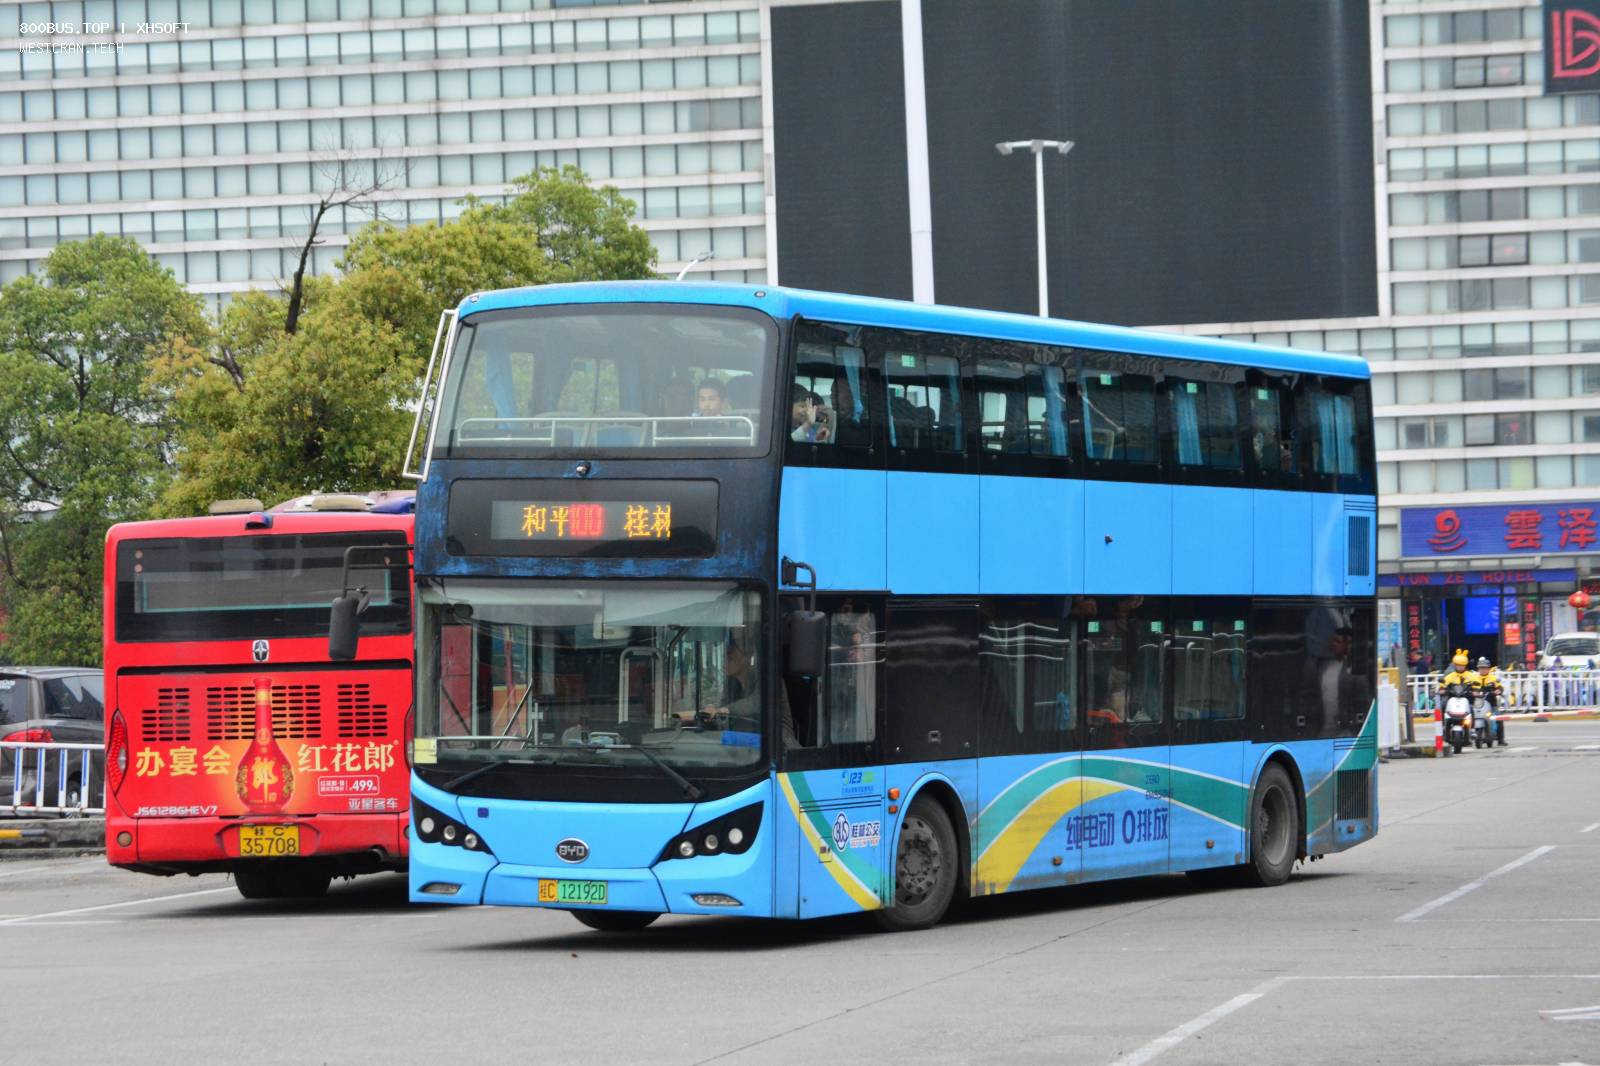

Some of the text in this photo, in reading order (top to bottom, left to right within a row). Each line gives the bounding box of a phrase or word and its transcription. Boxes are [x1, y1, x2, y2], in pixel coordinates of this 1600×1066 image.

[521, 504, 569, 536] 和平
[1398, 569, 1535, 585] YUN ZE HOTEL
[136, 745, 231, 777] 办宴会
[297, 741, 395, 773] 红花郎
[348, 798, 399, 811] 亚星客车
[1065, 811, 1115, 851] 纯电动
[242, 837, 297, 855] 35708
[559, 845, 585, 856] BYD
